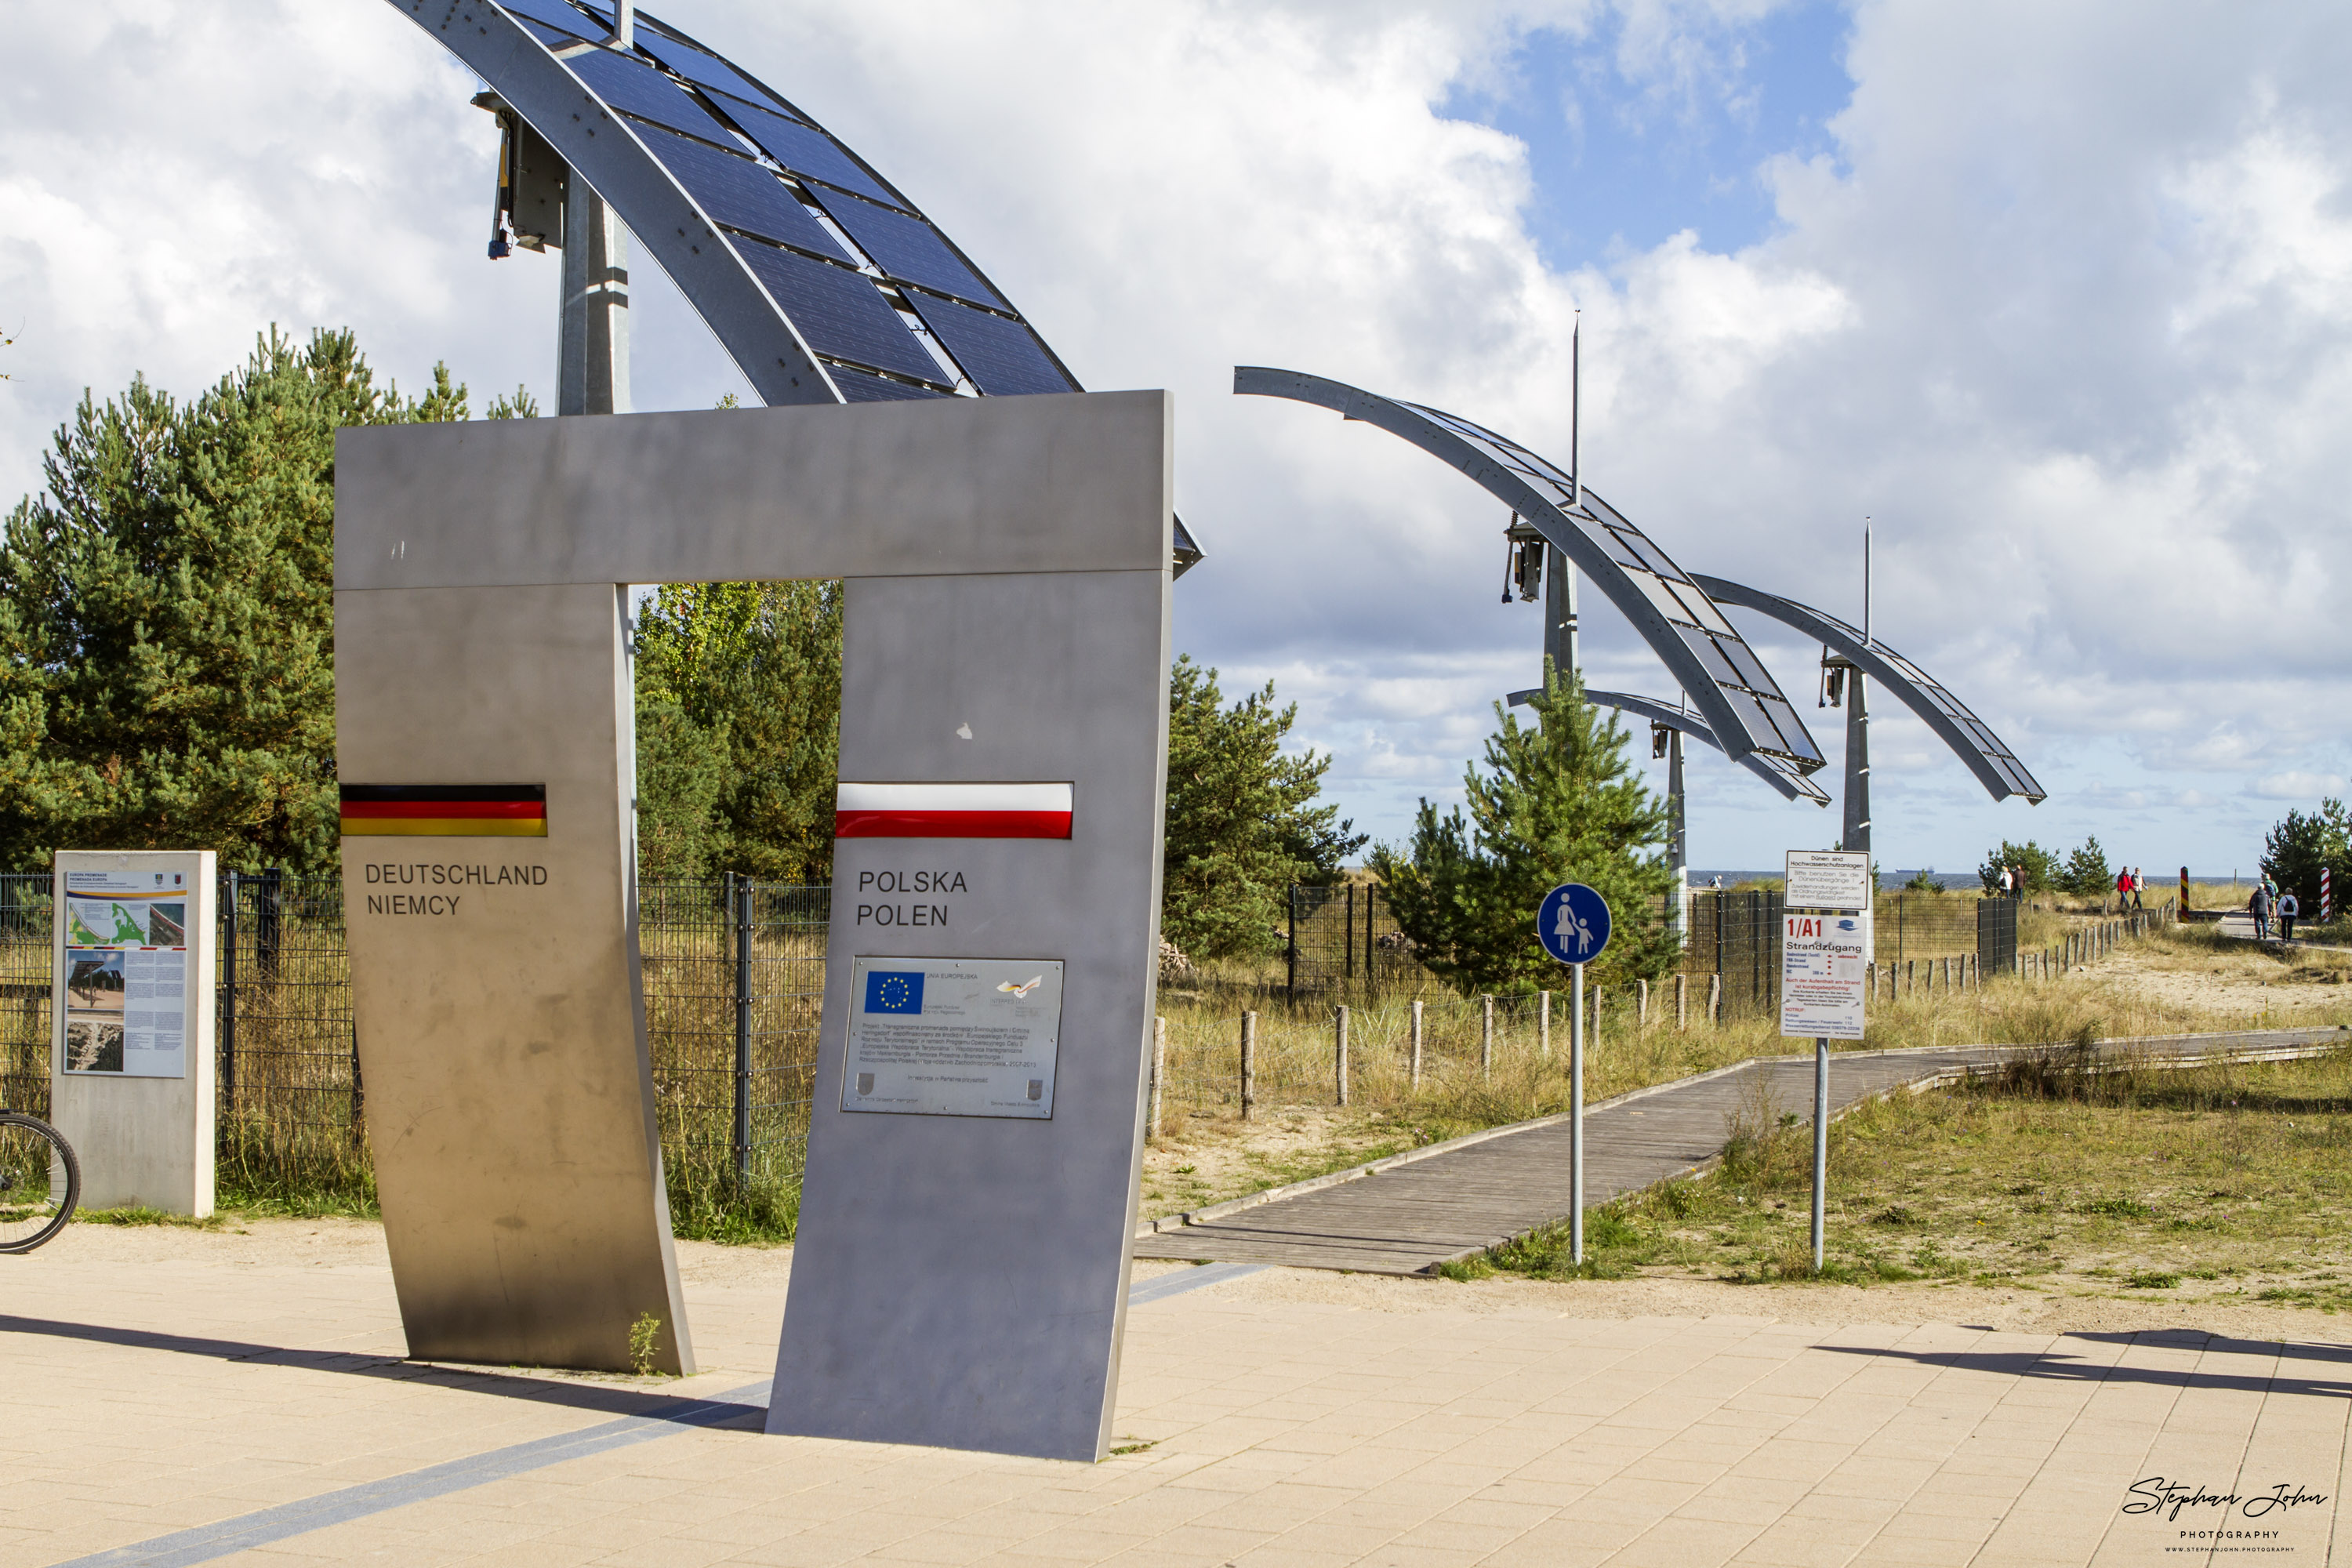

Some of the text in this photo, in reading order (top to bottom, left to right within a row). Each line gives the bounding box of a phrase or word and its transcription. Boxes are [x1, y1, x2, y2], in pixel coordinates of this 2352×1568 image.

[366, 865, 548, 886] DEUTSCHLAND
[859, 871, 967, 893] POLSKA
[368, 895, 460, 915] NIEMCY
[858, 905, 948, 926] POLEN
[1788, 918, 1821, 939] 1/A1
[1787, 942, 1862, 953] Strandzugang
